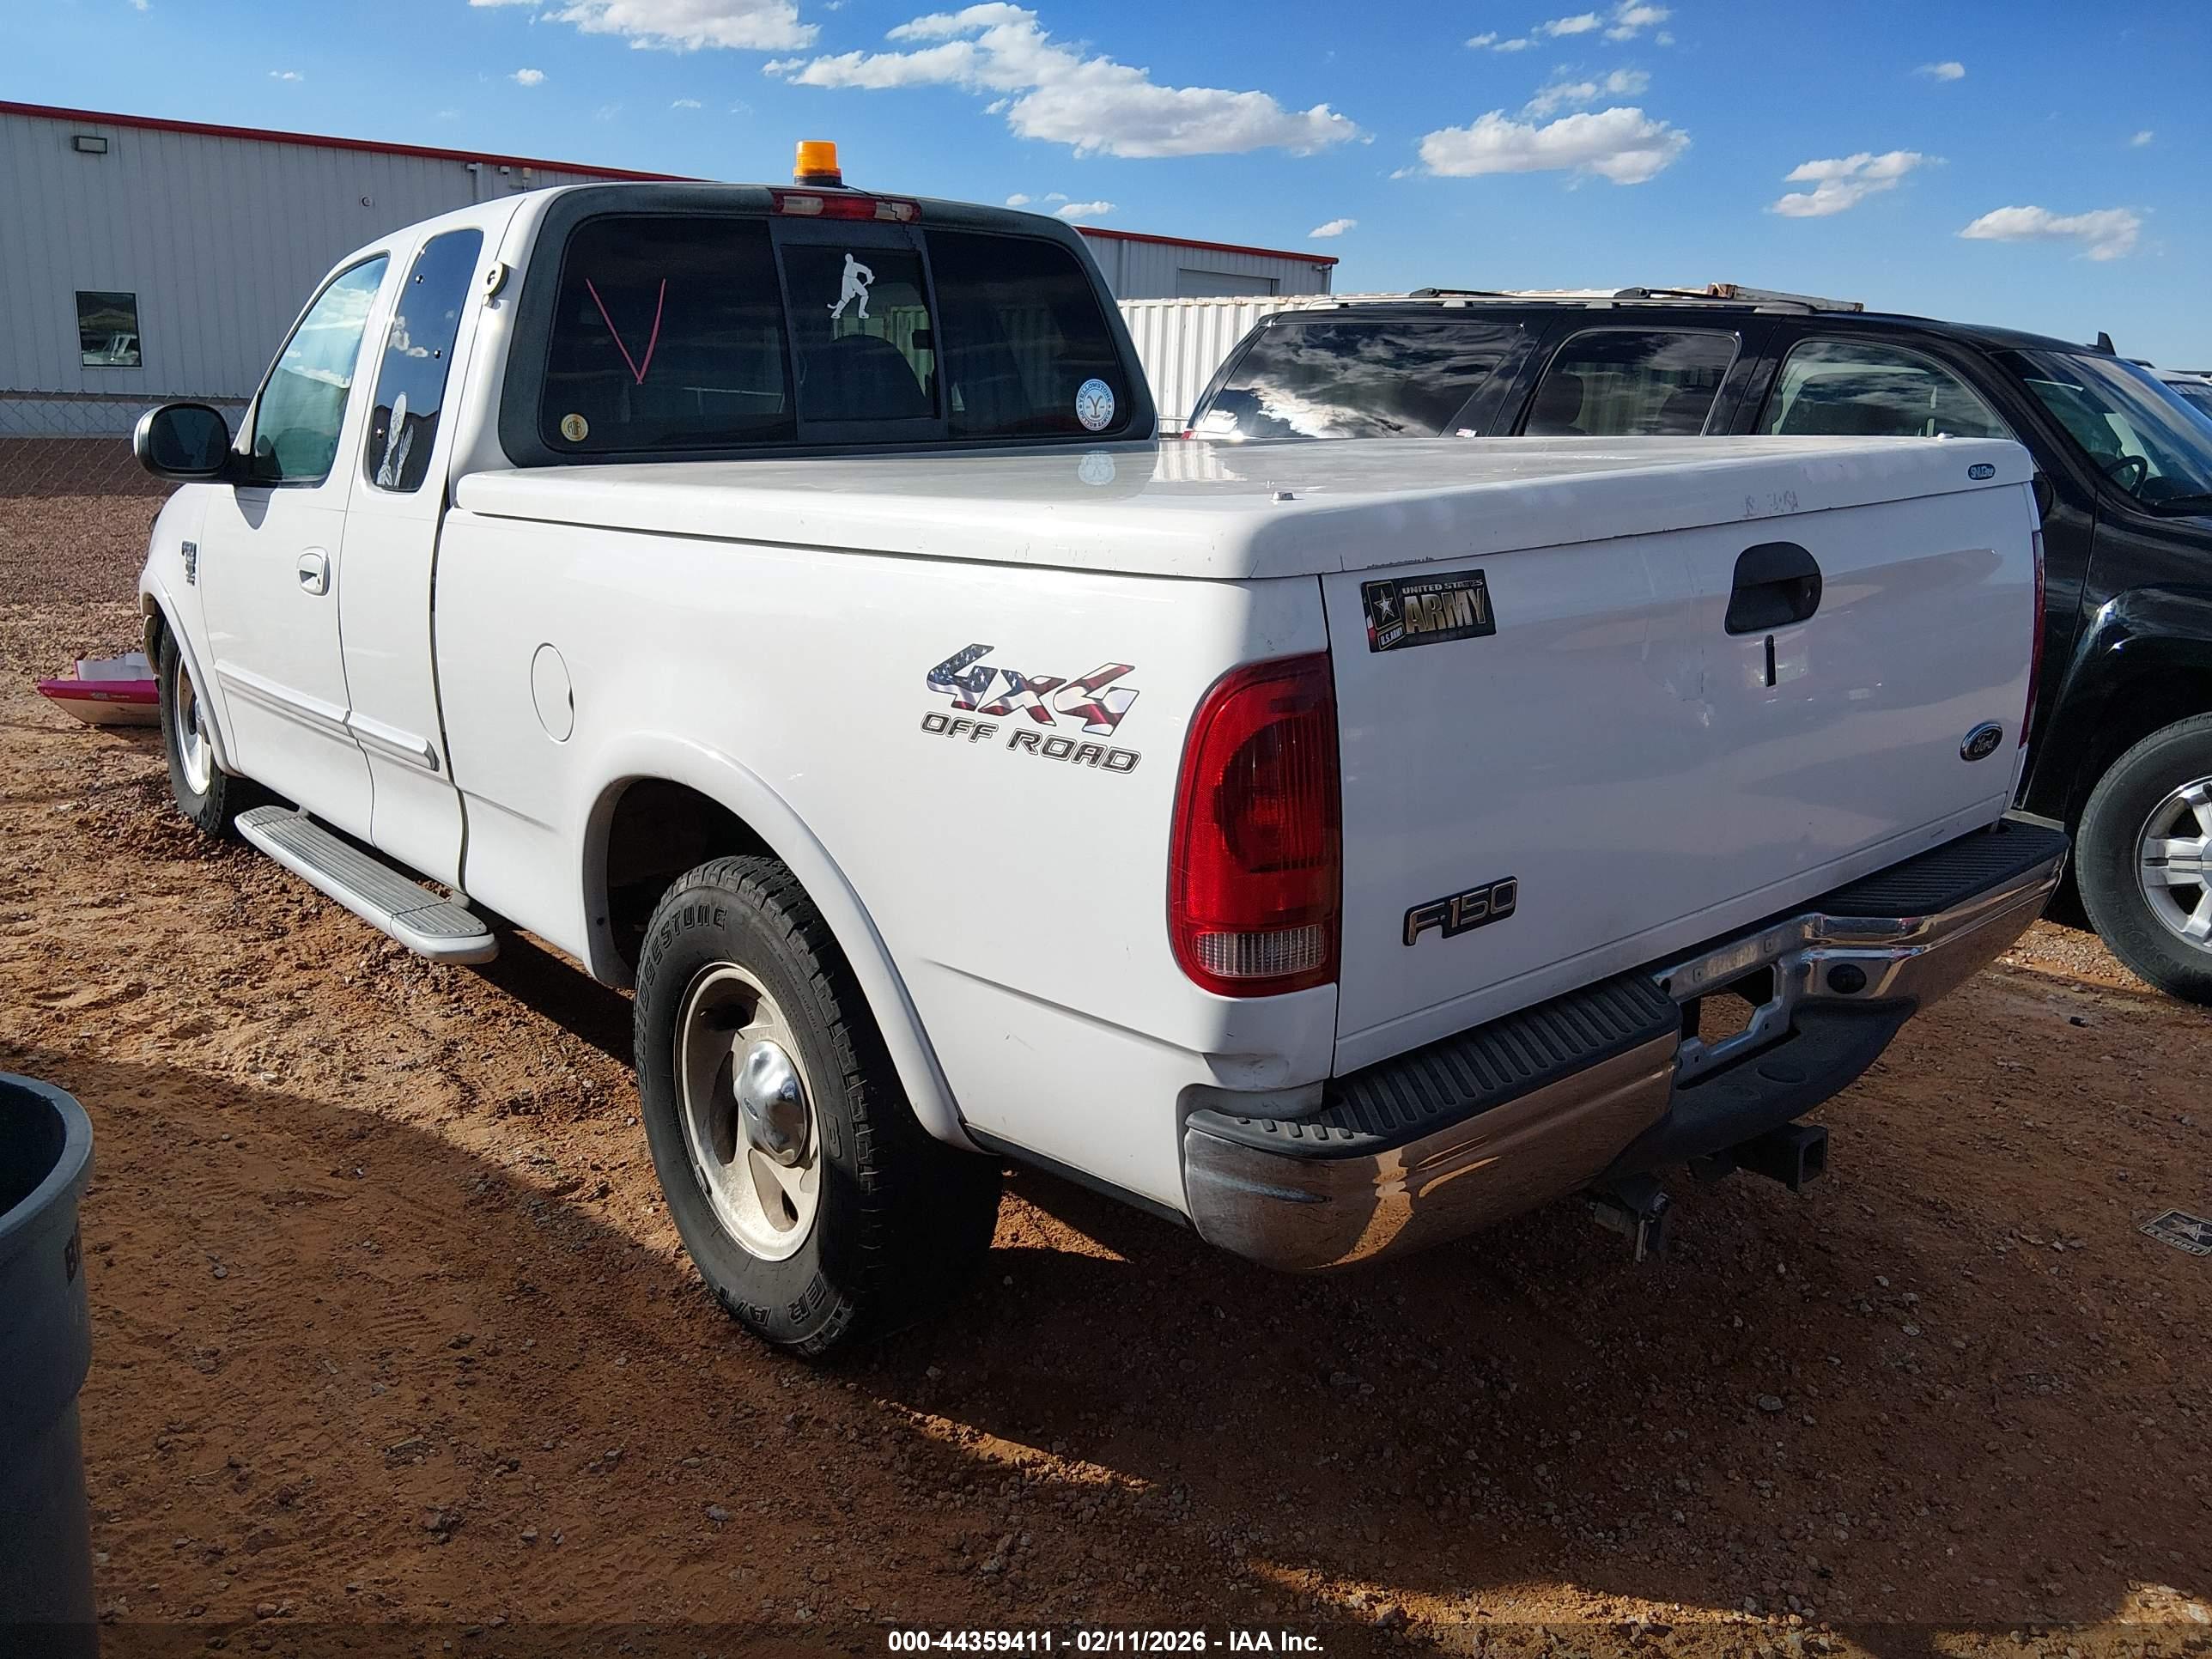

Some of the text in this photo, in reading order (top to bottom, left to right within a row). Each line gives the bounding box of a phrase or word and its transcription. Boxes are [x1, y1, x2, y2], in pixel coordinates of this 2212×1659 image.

[1401, 579, 1484, 596] UNITED STATES
[1403, 587, 1486, 635] ARMY
[921, 711, 1142, 775] OFF ROAD
[635, 903, 728, 1092] BRIDGESTONE
